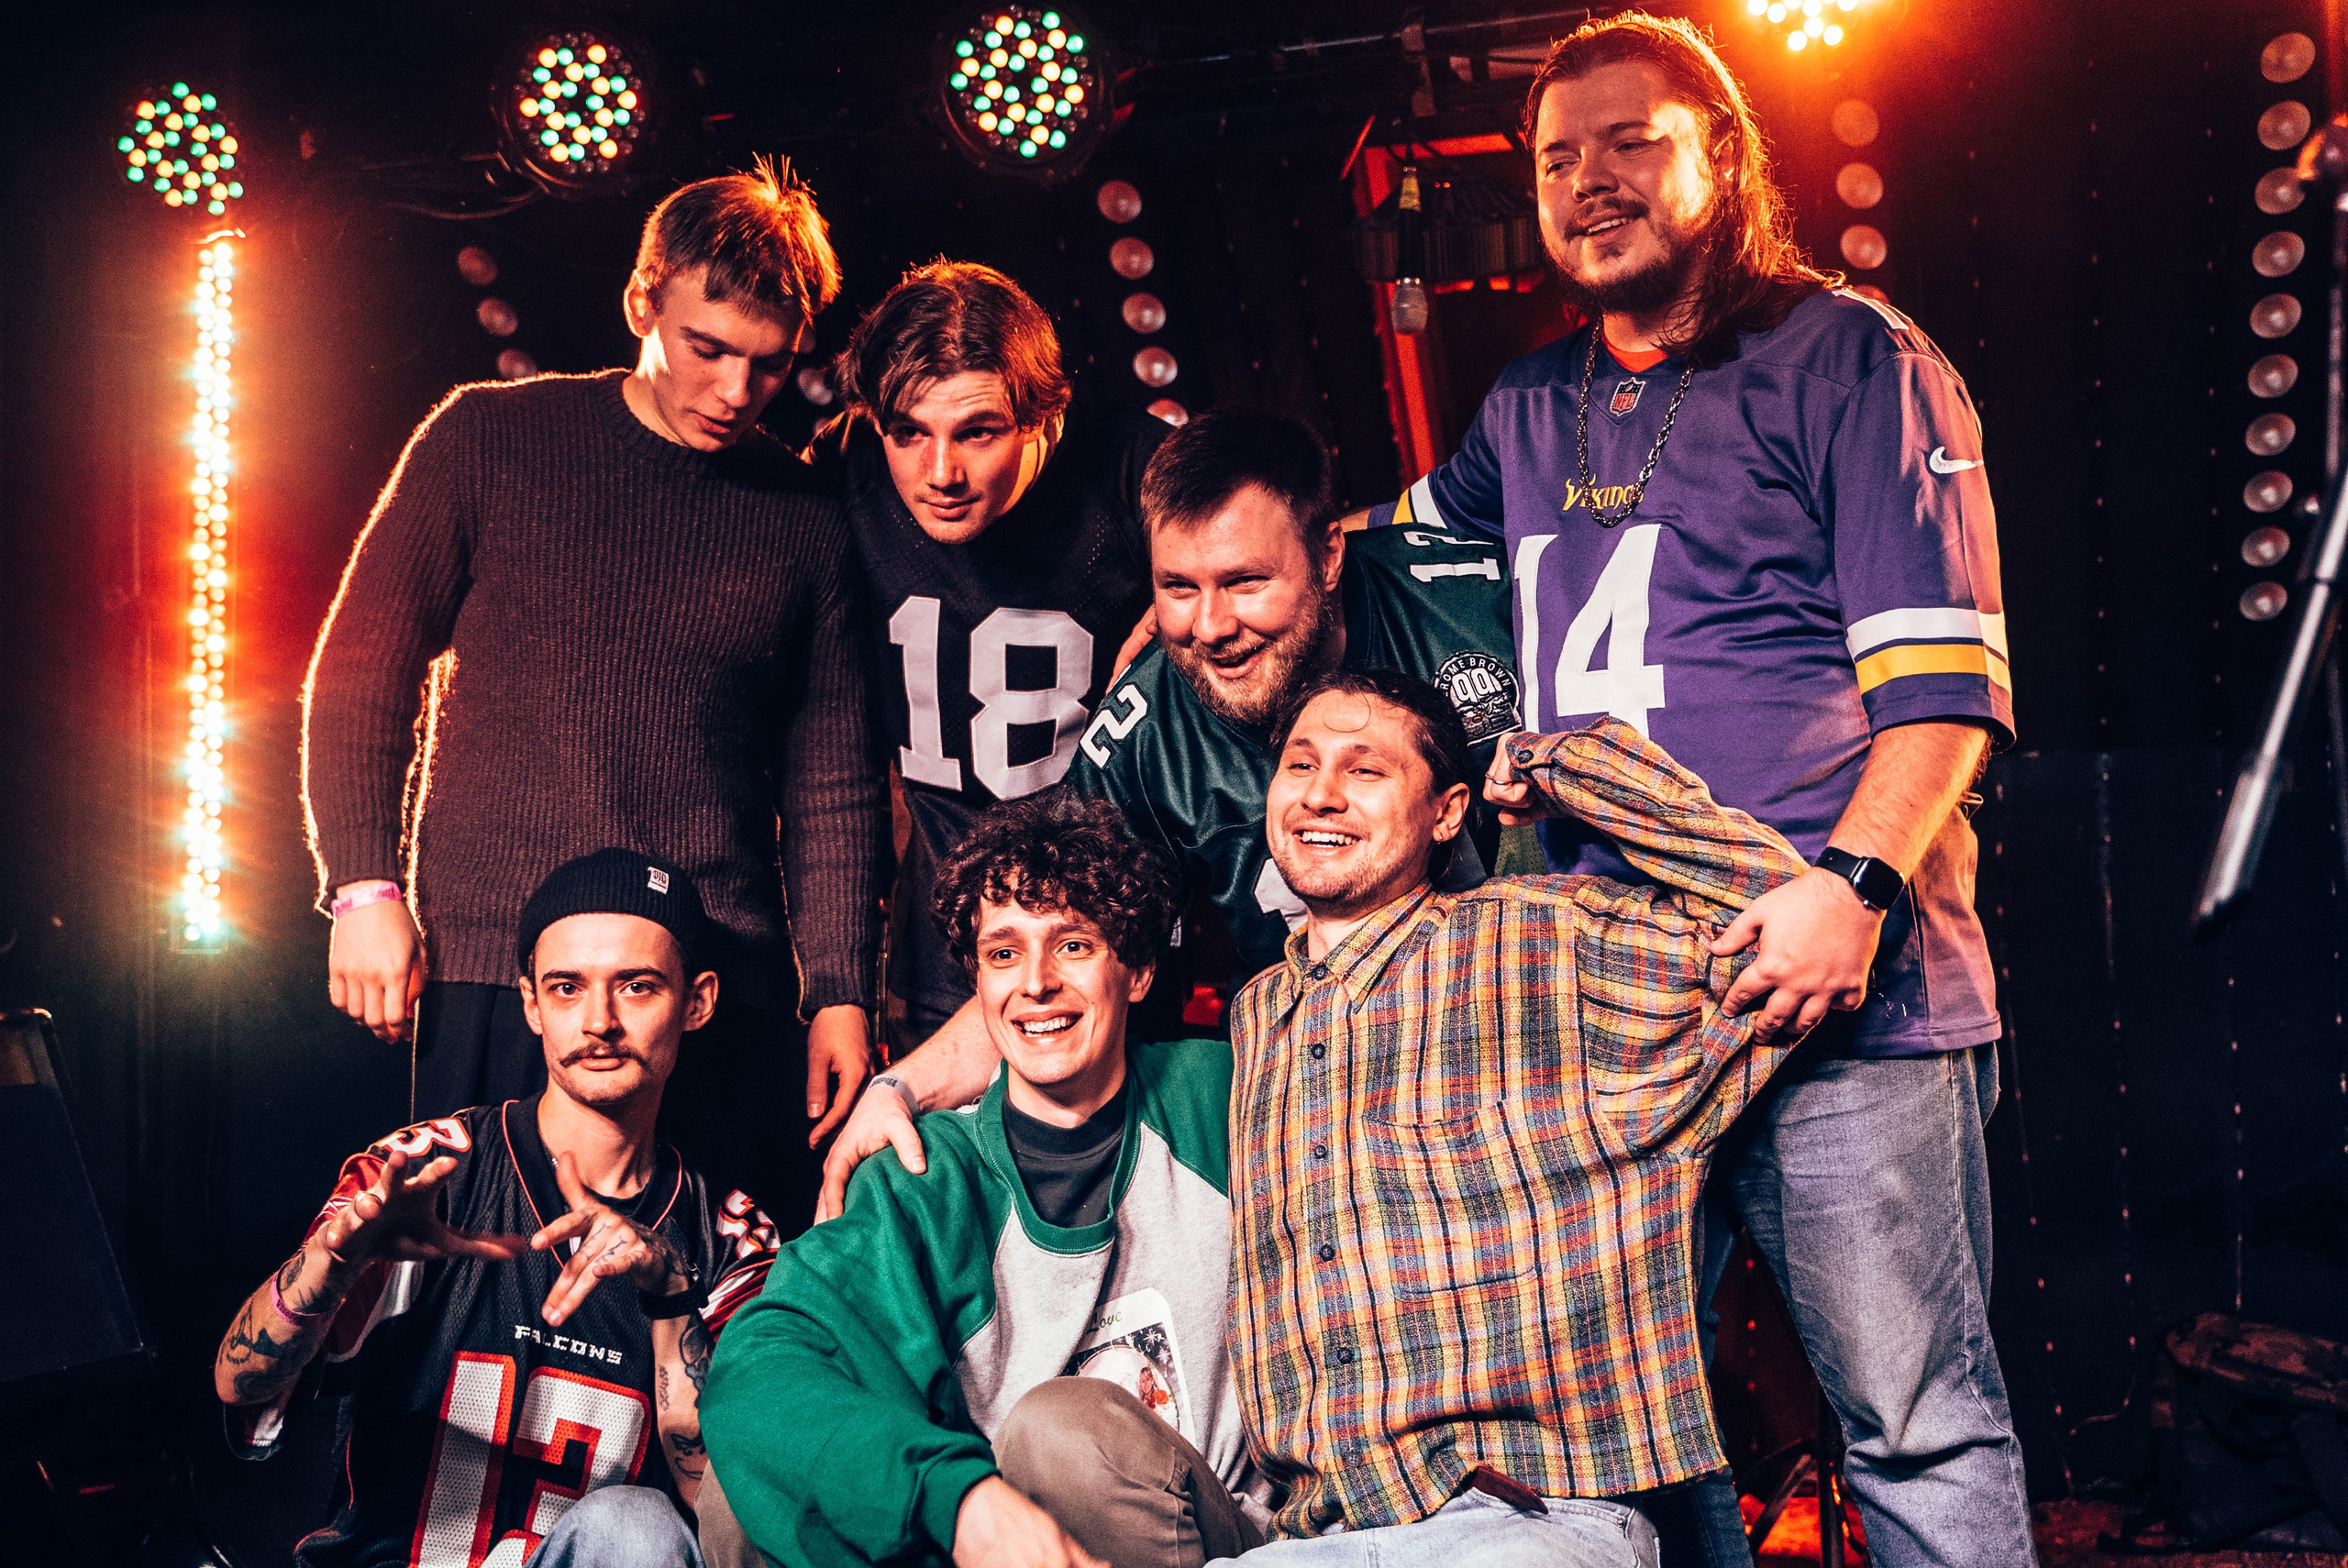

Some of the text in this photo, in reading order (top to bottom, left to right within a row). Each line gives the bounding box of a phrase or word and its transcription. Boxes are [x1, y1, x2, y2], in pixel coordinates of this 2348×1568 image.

[1614, 393, 1634, 409] NFL
[1514, 524, 1666, 739] 14
[1469, 657, 1512, 686] BROWN
[889, 595, 1093, 801] 18
[515, 1325, 623, 1364] FALCONS
